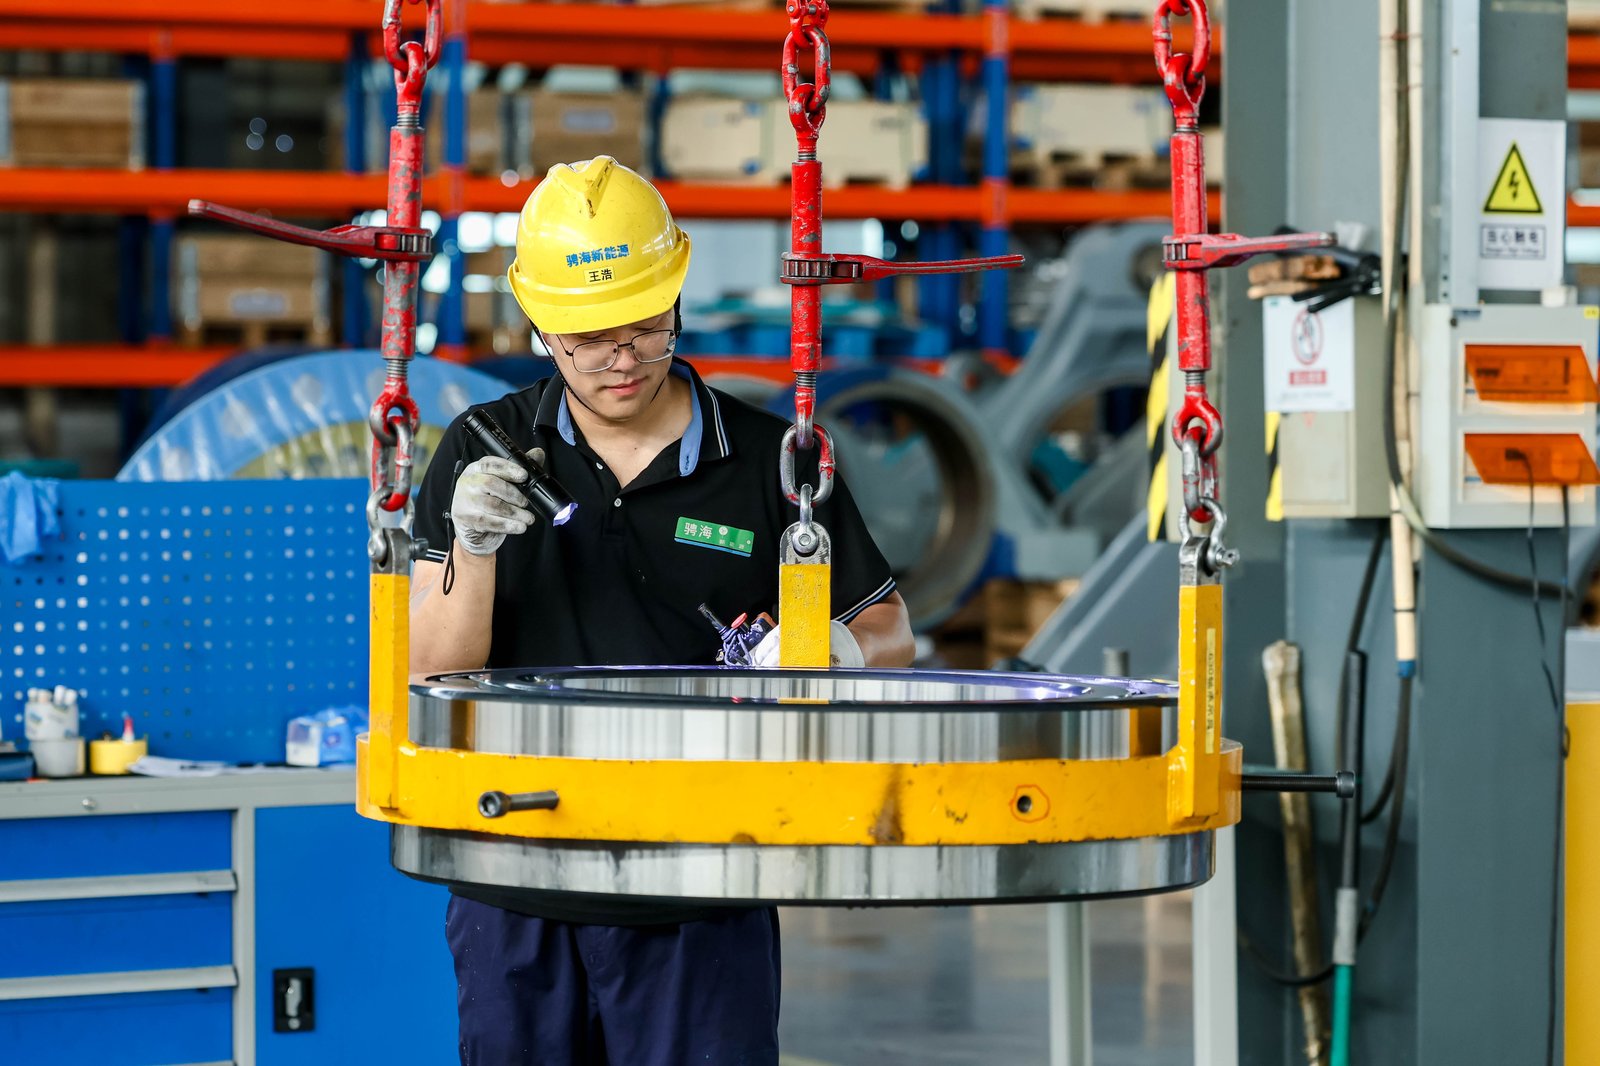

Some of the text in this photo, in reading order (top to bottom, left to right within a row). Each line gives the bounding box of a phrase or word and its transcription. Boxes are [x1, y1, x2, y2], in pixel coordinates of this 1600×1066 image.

[565, 243, 630, 268] 骋海新能源
[588, 268, 613, 283] 王浩
[683, 522, 713, 539] 骋海
